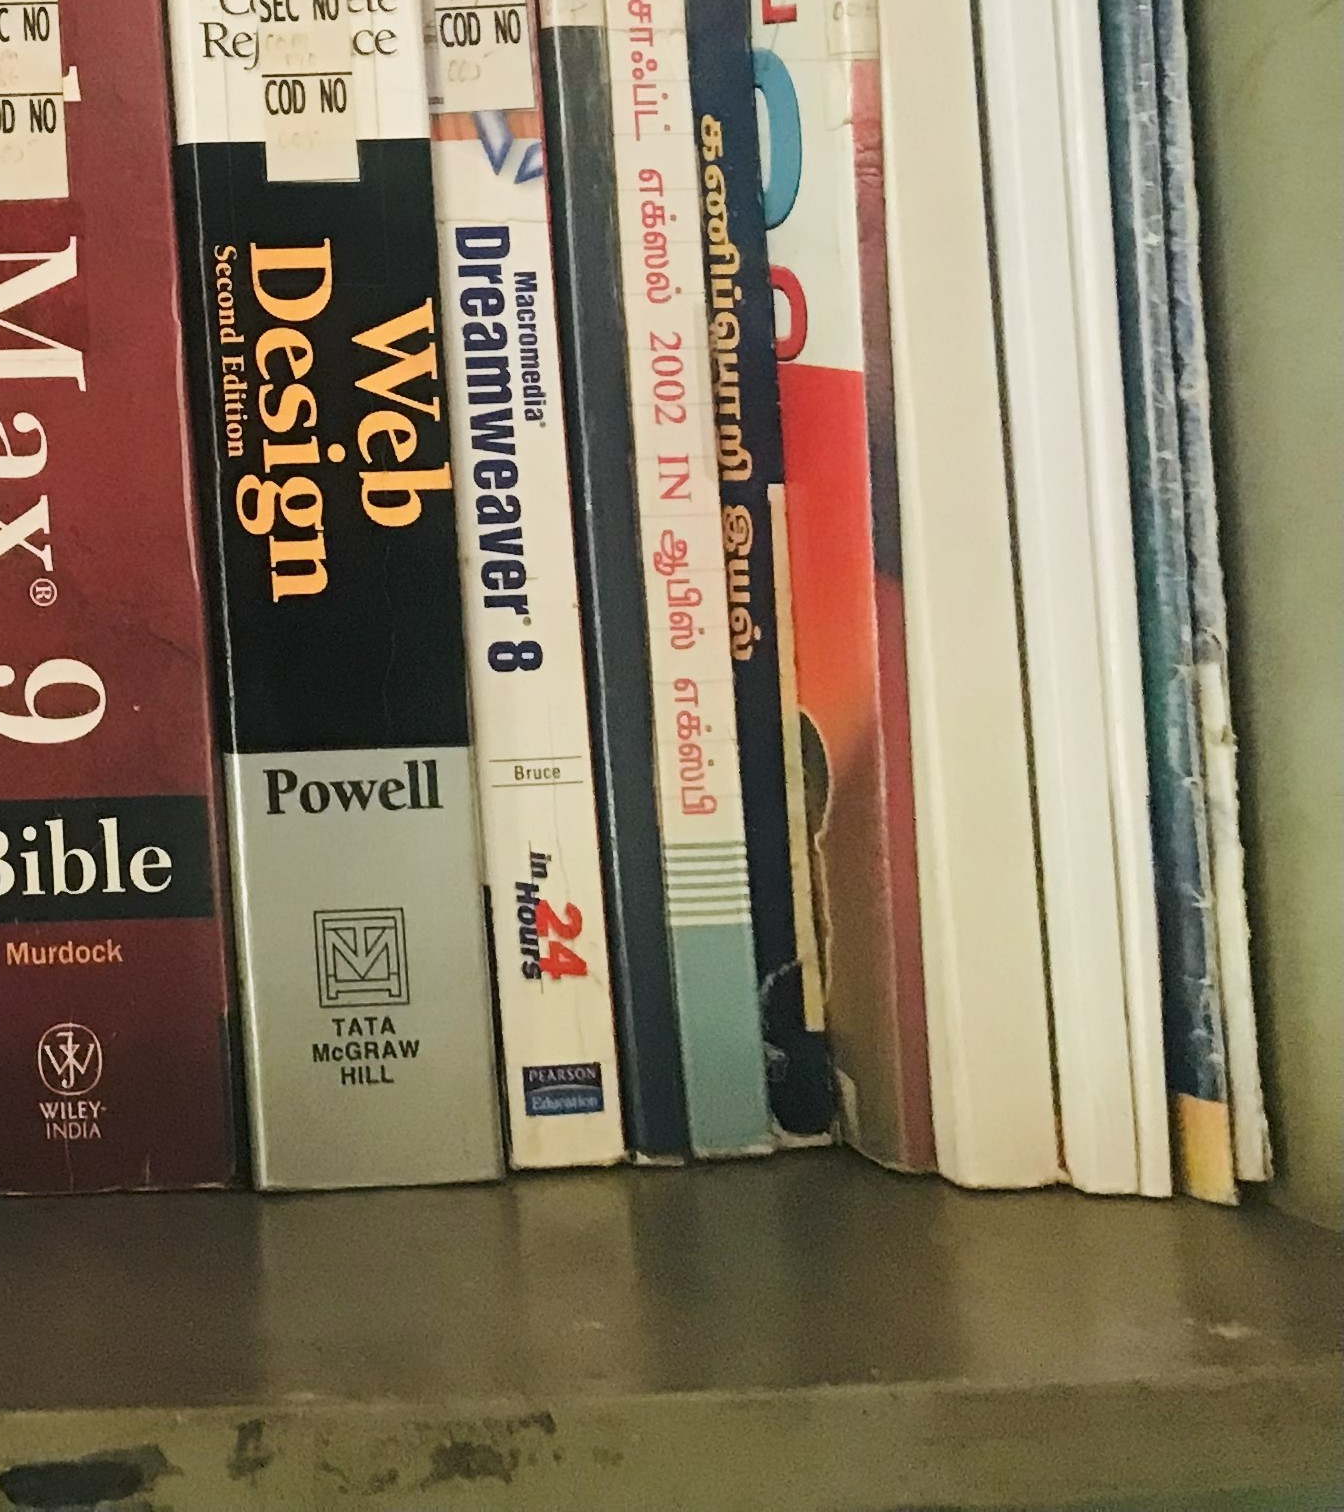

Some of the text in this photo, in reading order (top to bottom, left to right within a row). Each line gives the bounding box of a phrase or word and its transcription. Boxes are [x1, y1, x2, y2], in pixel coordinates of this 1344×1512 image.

[214, 244, 246, 458] Second Edition
[513, 271, 544, 422] Macromedia
[648, 330, 686, 425] 2002
[235, 238, 347, 602] Design
[350, 296, 453, 528] Web
[454, 225, 543, 673] Dreamweaver 8
[660, 454, 691, 502] IN
[264, 758, 444, 816] Powell
[514, 762, 561, 782] Bruce
[516, 882, 543, 980] Hours
[528, 849, 588, 980] in 24
[5, 939, 123, 966] Murdock
[312, 1039, 420, 1063] McGRAW
[332, 1018, 396, 1037] TATA
[340, 1064, 393, 1086] HILL
[527, 1066, 597, 1083] PEARSON
[531, 1092, 598, 1112] Education
